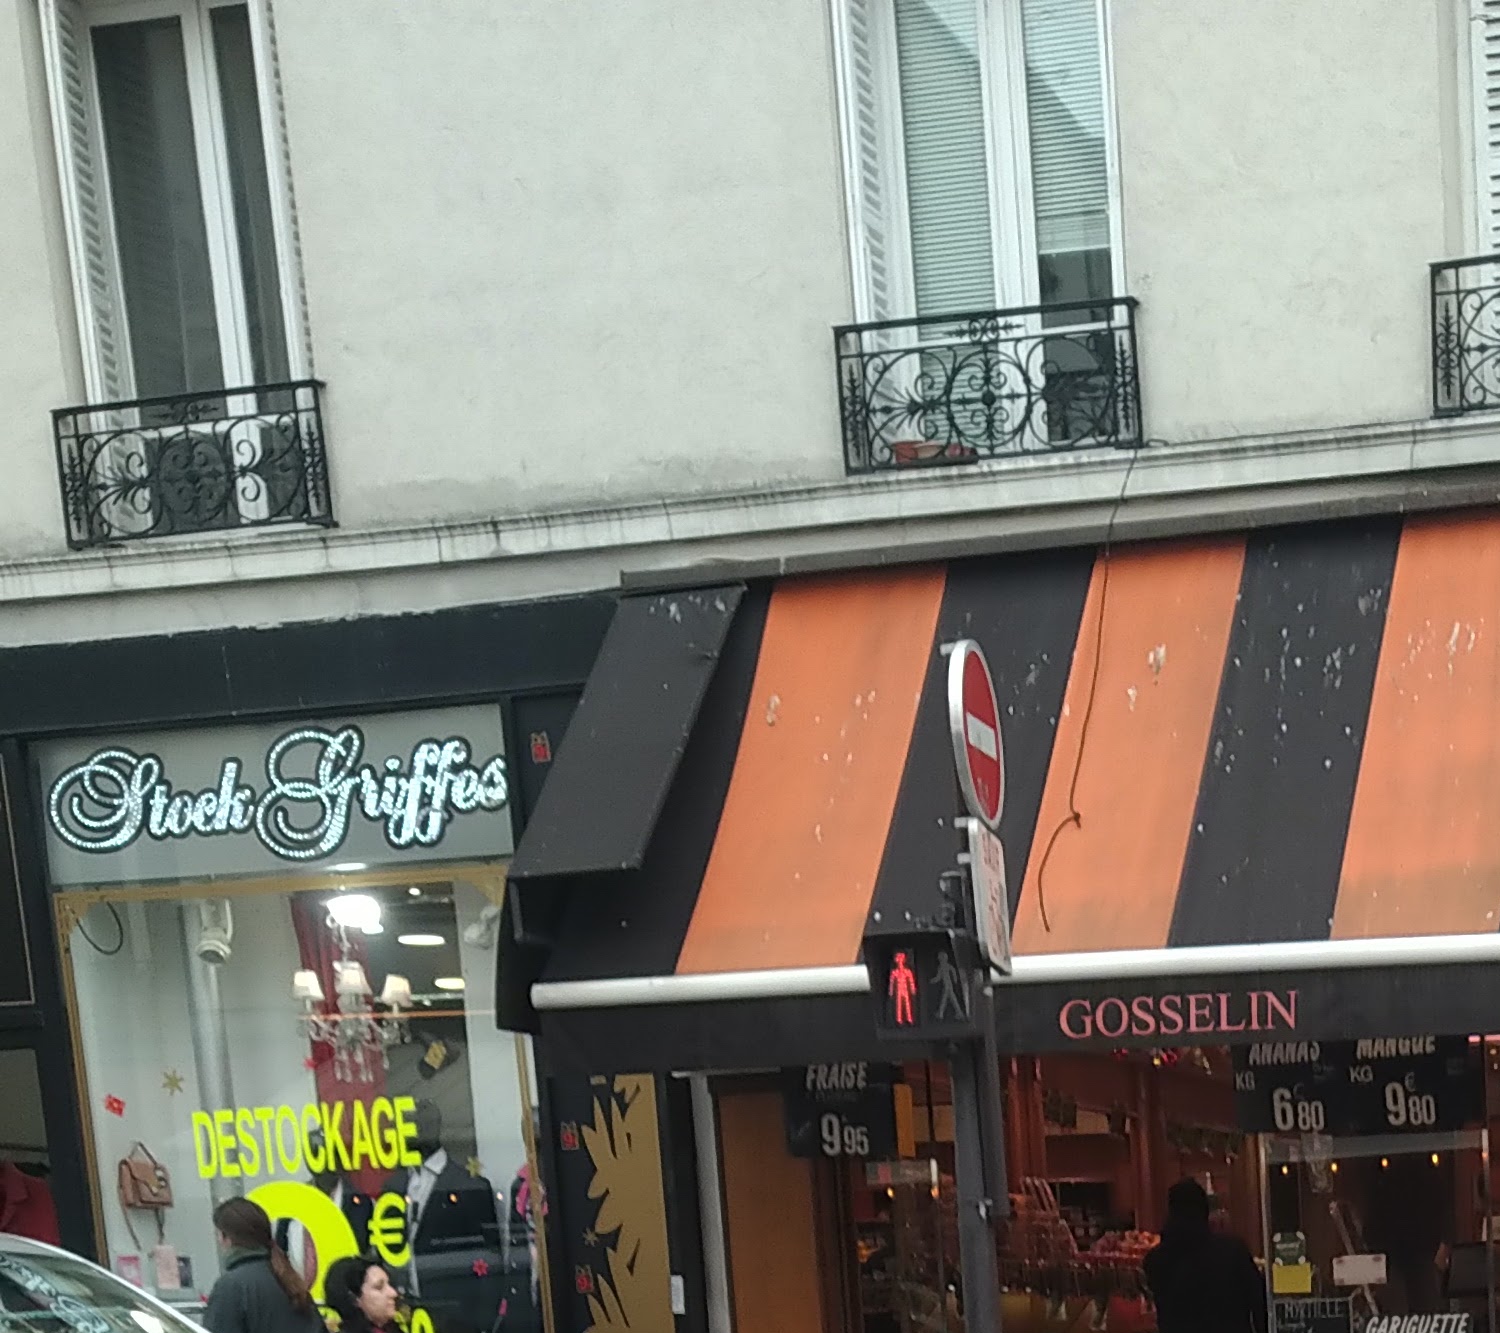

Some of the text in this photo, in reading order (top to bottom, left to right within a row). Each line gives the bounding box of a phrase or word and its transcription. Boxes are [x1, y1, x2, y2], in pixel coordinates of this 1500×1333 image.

[48, 724, 509, 861] Stock Griffes
[1058, 989, 1299, 1041] GOSSELIN
[1249, 1040, 1321, 1066] ANANAS
[1356, 1035, 1436, 1061] MANGUE
[805, 1061, 869, 1091] FRAISE
[1235, 1071, 1256, 1091] KG
[1350, 1065, 1373, 1083] KG
[192, 1096, 422, 1179] DESTOCKAGE
